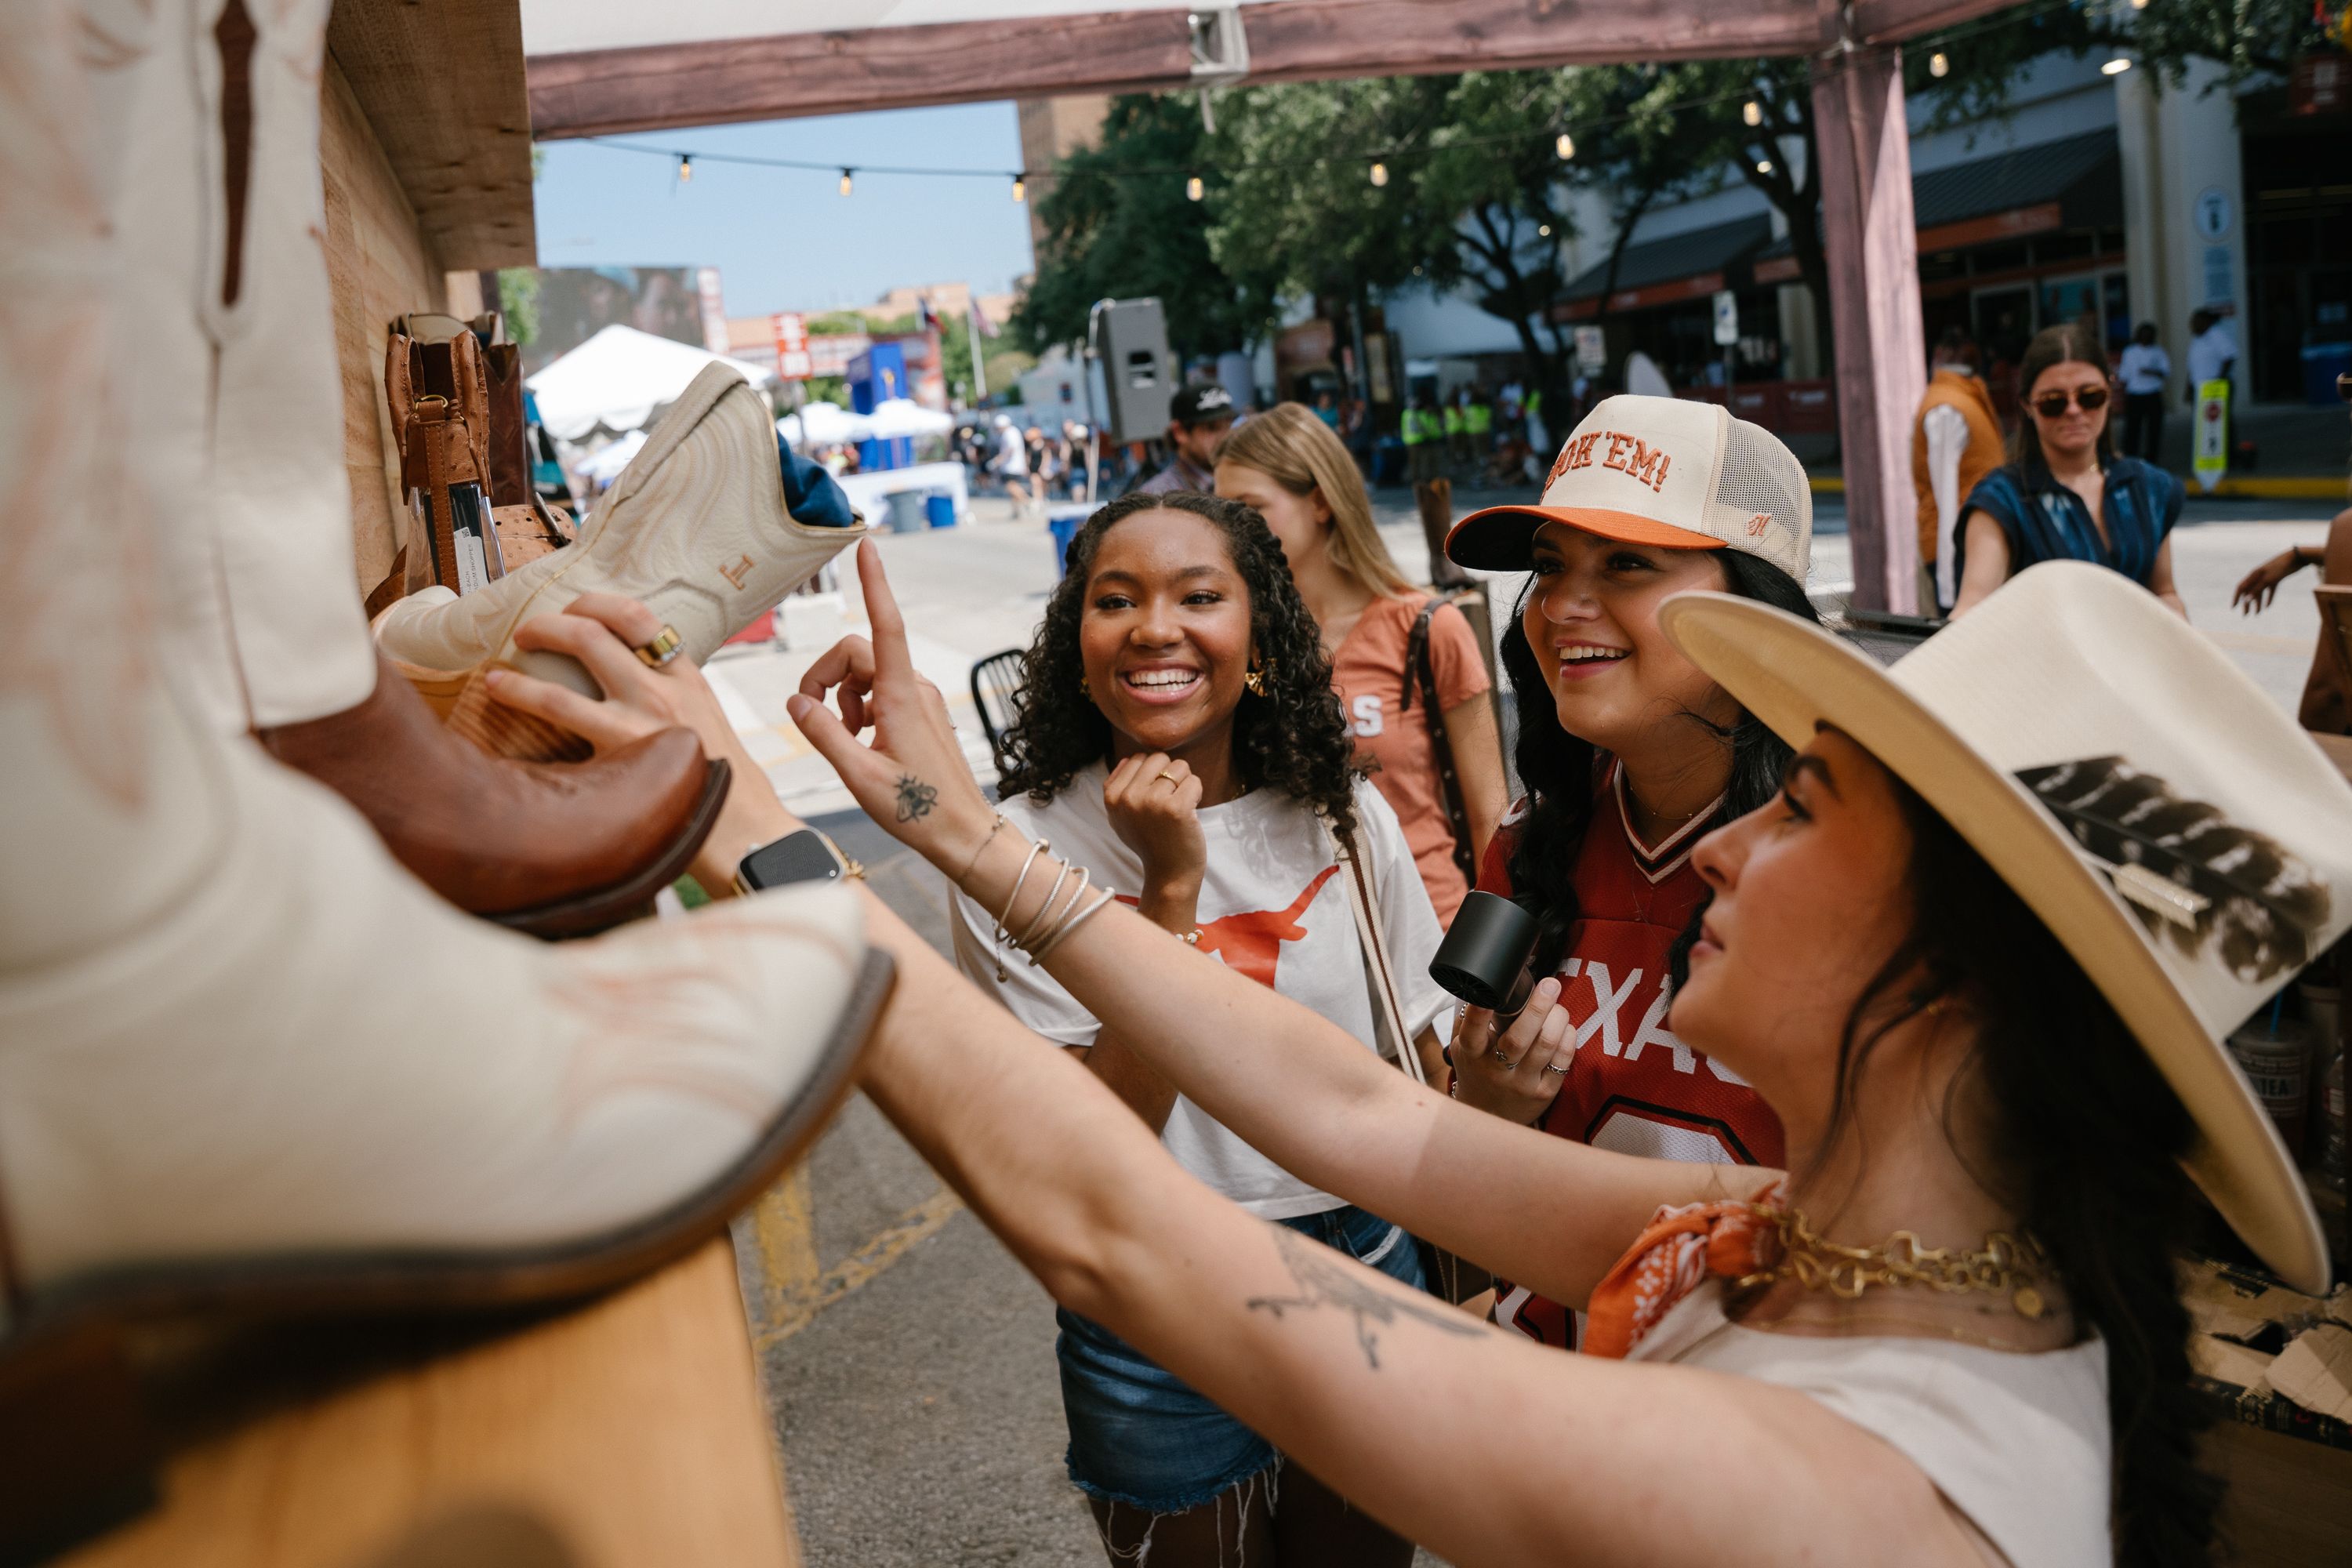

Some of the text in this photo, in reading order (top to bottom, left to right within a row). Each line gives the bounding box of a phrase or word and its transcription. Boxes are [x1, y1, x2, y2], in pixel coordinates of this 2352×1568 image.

[1602, 430, 1671, 493] 'EM!
[468, 544, 477, 572] SHOPPER
[1341, 695, 1383, 738] S
[1555, 957, 1754, 1088] XA
